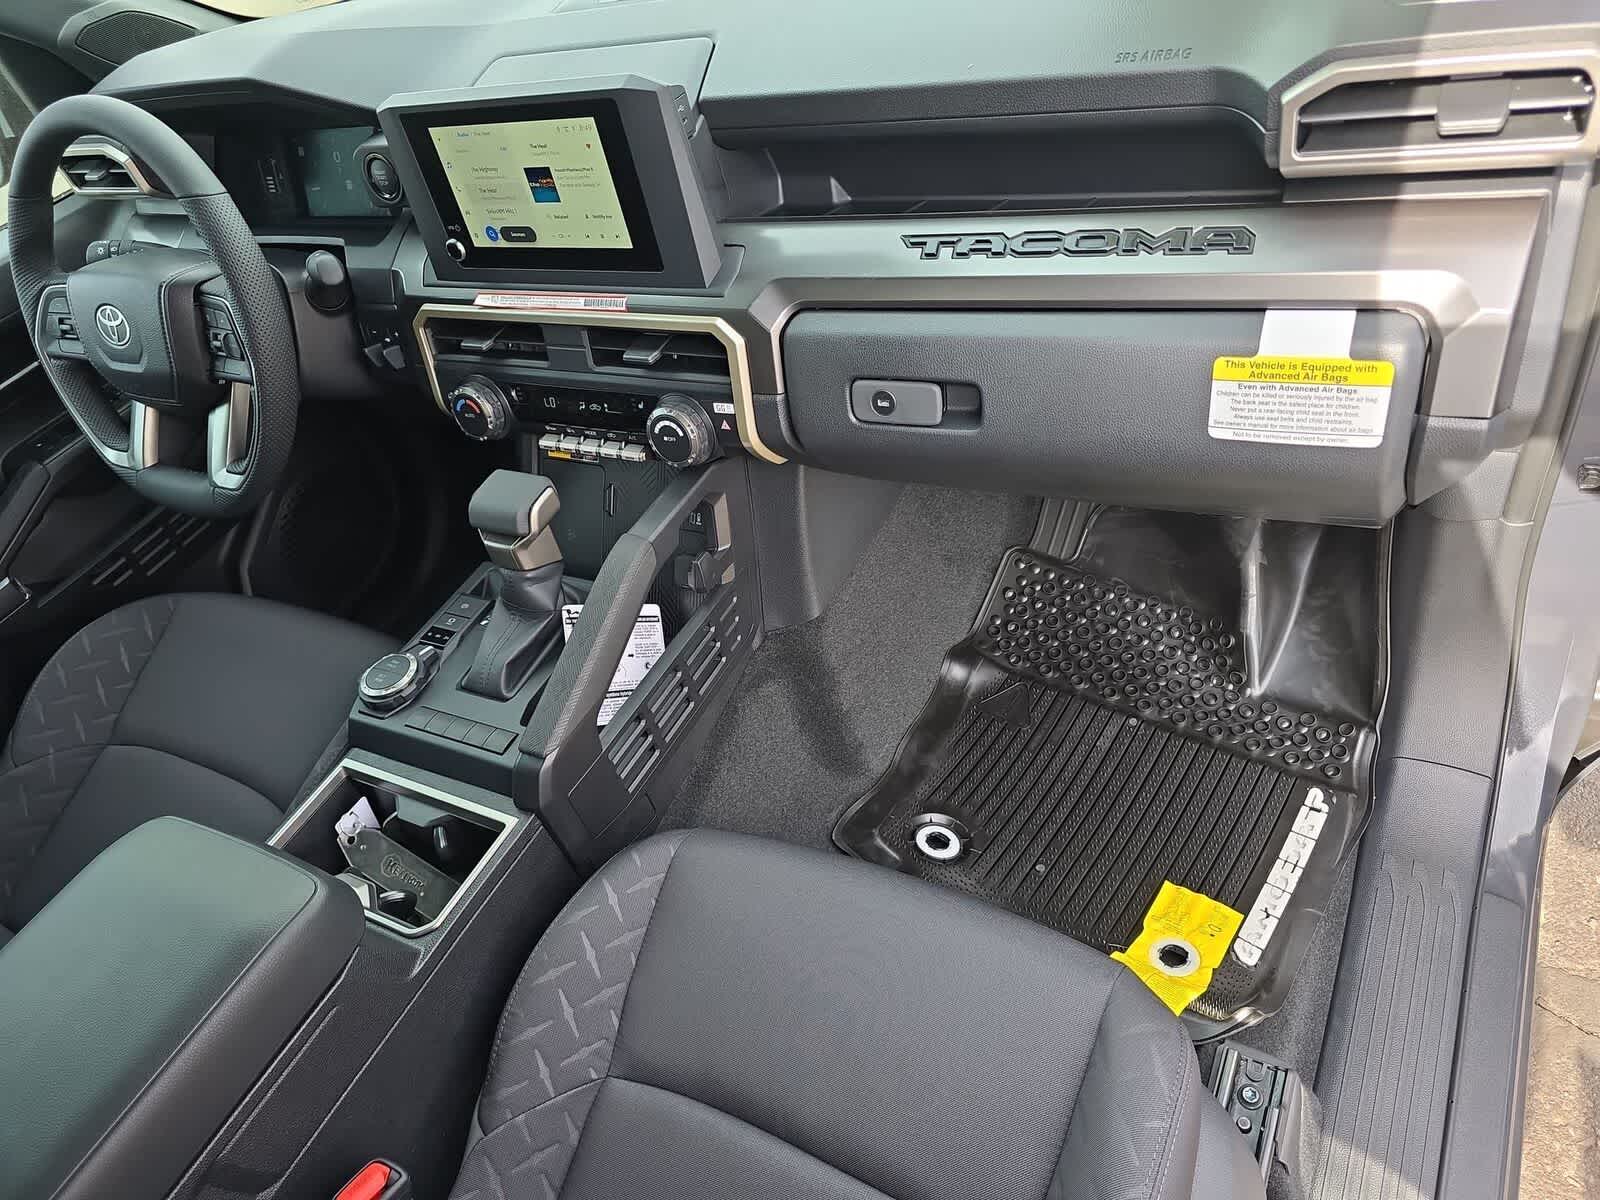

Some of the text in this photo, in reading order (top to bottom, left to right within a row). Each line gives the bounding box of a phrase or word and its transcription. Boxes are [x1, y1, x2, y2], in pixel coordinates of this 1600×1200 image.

[1115, 47, 1192, 63] SRS AIRBAG
[900, 225, 1256, 260] TACOMA
[1225, 359, 1377, 374] This Vehicle is Equipped with
[1248, 370, 1348, 384] Advanced Air Bags
[1260, 383, 1276, 391] with
[1279, 384, 1319, 393] Advanced
[1336, 386, 1357, 395] Bags
